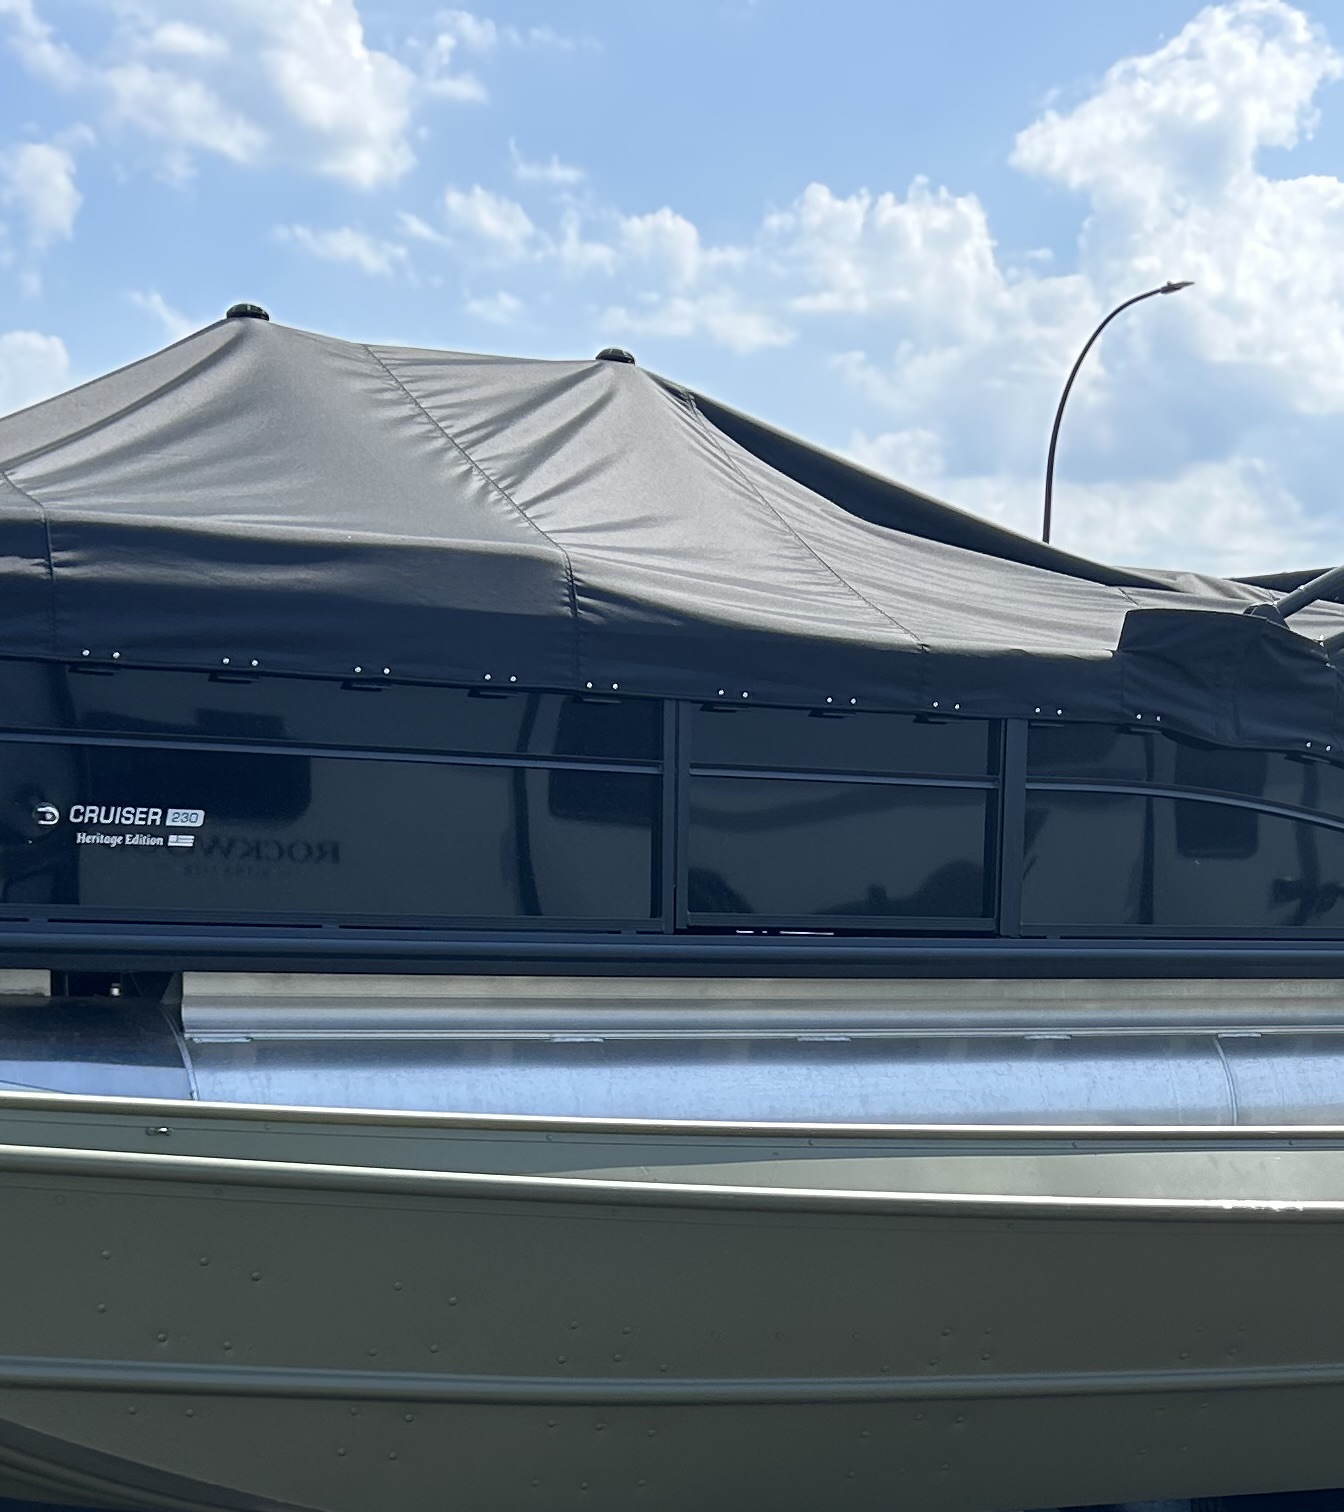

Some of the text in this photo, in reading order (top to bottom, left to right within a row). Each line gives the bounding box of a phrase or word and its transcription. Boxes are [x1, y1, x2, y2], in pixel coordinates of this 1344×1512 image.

[68, 804, 199, 826] CRUISER 230
[76, 832, 164, 848] Heritage Edition
